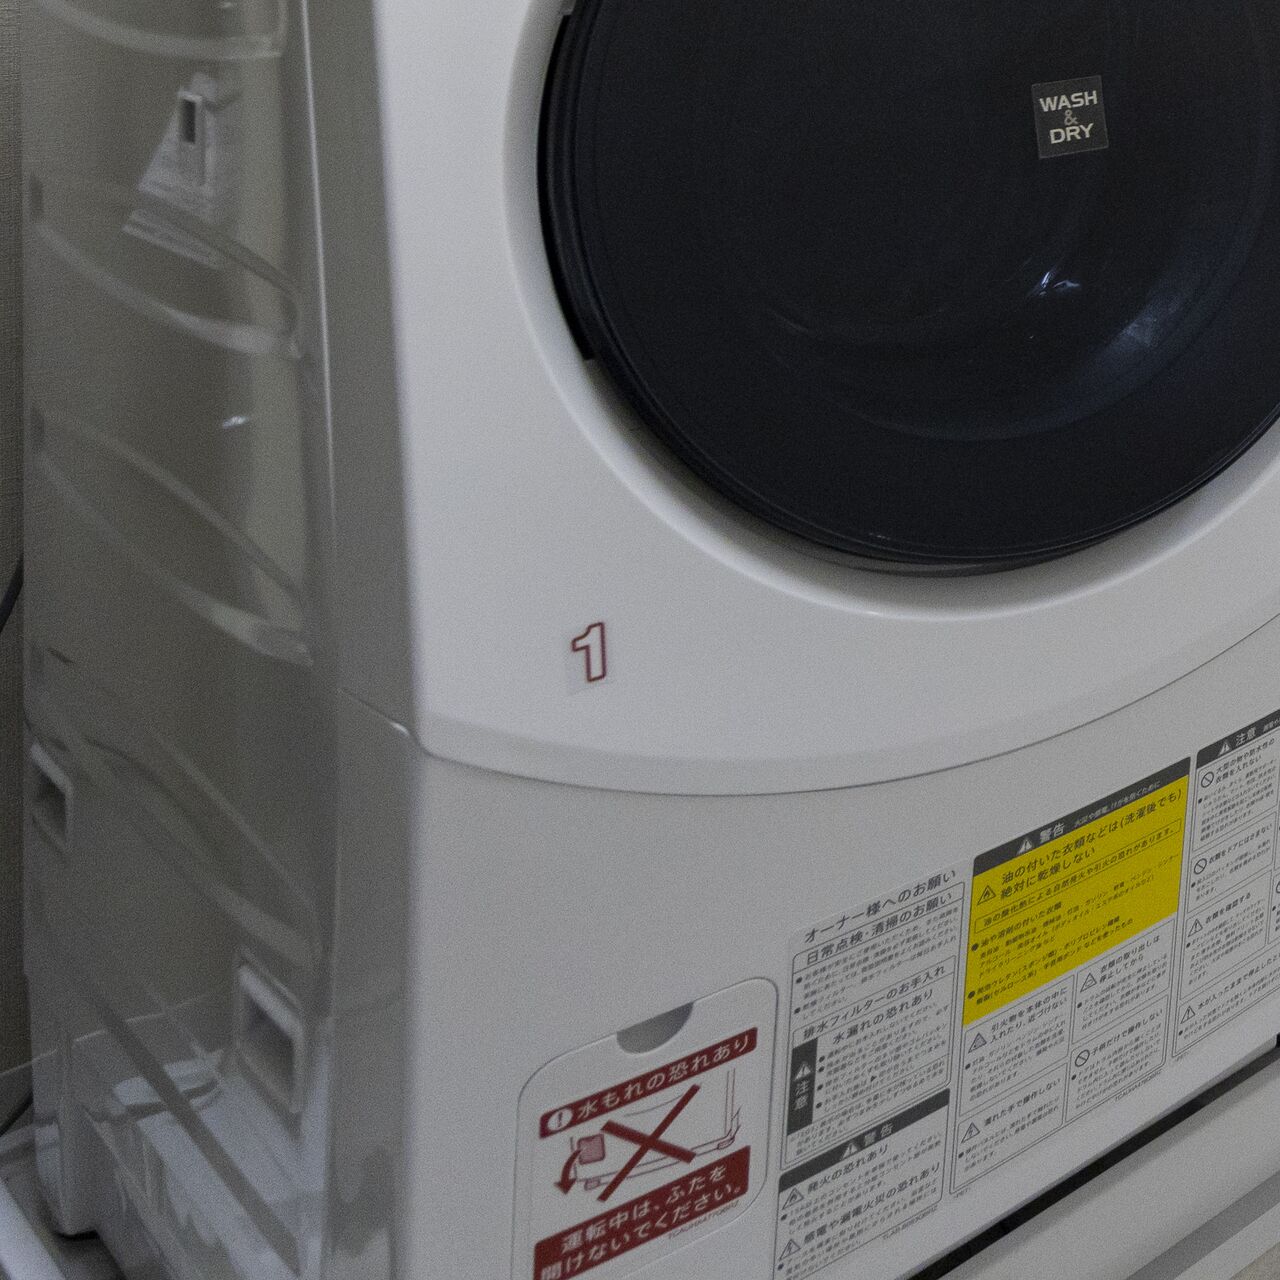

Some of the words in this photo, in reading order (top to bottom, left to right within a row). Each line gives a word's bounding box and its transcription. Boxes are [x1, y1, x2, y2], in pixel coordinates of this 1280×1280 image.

[1040, 90, 1098, 113] WASH
[1063, 109, 1078, 126] &
[1050, 123, 1094, 144] DRY
[571, 621, 606, 683] 1
[1234, 727, 1257, 748] 注意
[1039, 821, 1065, 845] 警告
[1000, 849, 1095, 901] 絶対に乾燥しない
[805, 870, 955, 944] オーナー様へのお願い
[806, 892, 953, 966] 日常点検・清掃のお願い
[803, 965, 945, 1040] 排水フィルターのお手入れ
[832, 988, 933, 1045] 水漏れの恐れあり
[577, 1035, 749, 1121] 水もれの恐れあり
[540, 1185, 750, 1280] 開けないでください。
[560, 1166, 728, 1254] 運転中は、ふたを
